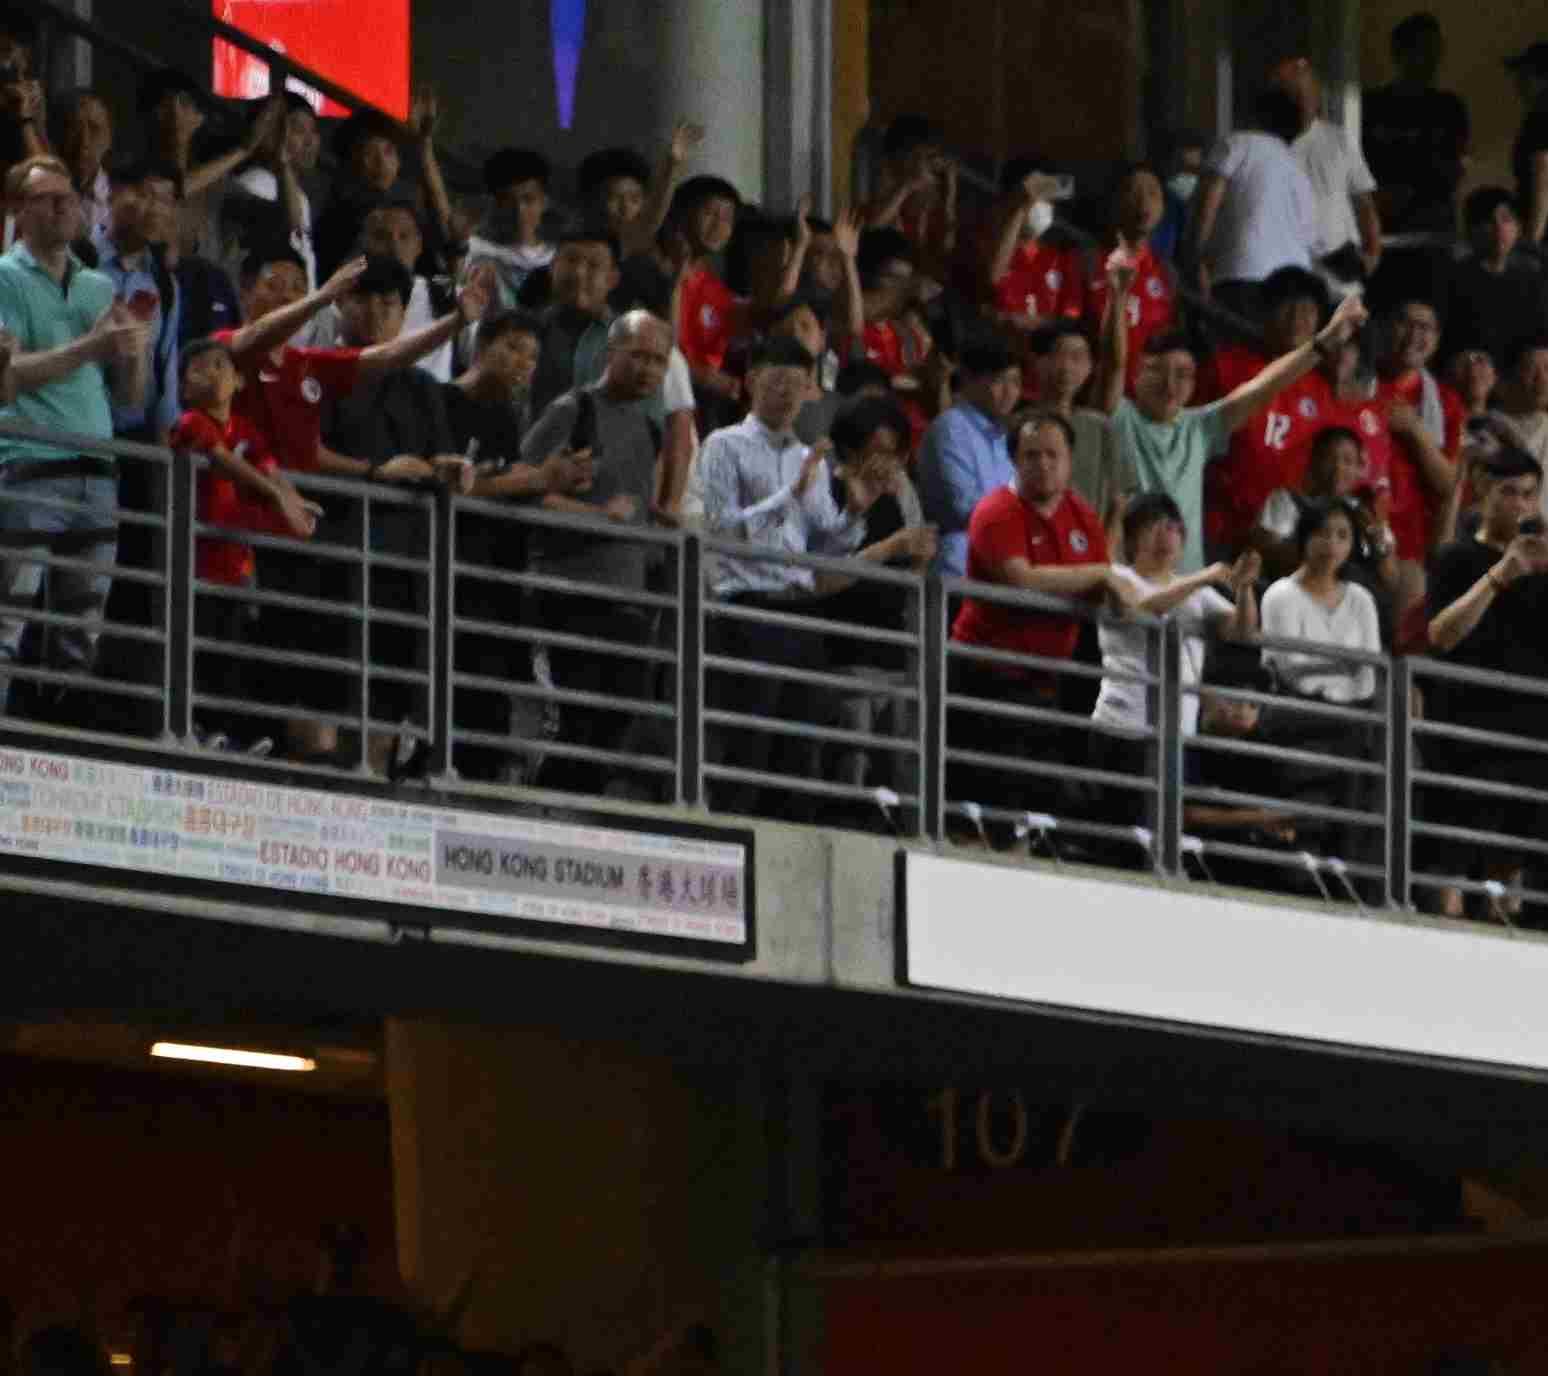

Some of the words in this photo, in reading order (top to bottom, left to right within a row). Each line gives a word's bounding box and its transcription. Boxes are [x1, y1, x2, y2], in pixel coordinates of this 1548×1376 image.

[257, 839, 329, 872] ESTADIO
[334, 847, 381, 877] HONG
[384, 853, 431, 883] KONG
[443, 844, 494, 876] HONG
[499, 849, 548, 882] KONG
[552, 857, 625, 891] STADIUM
